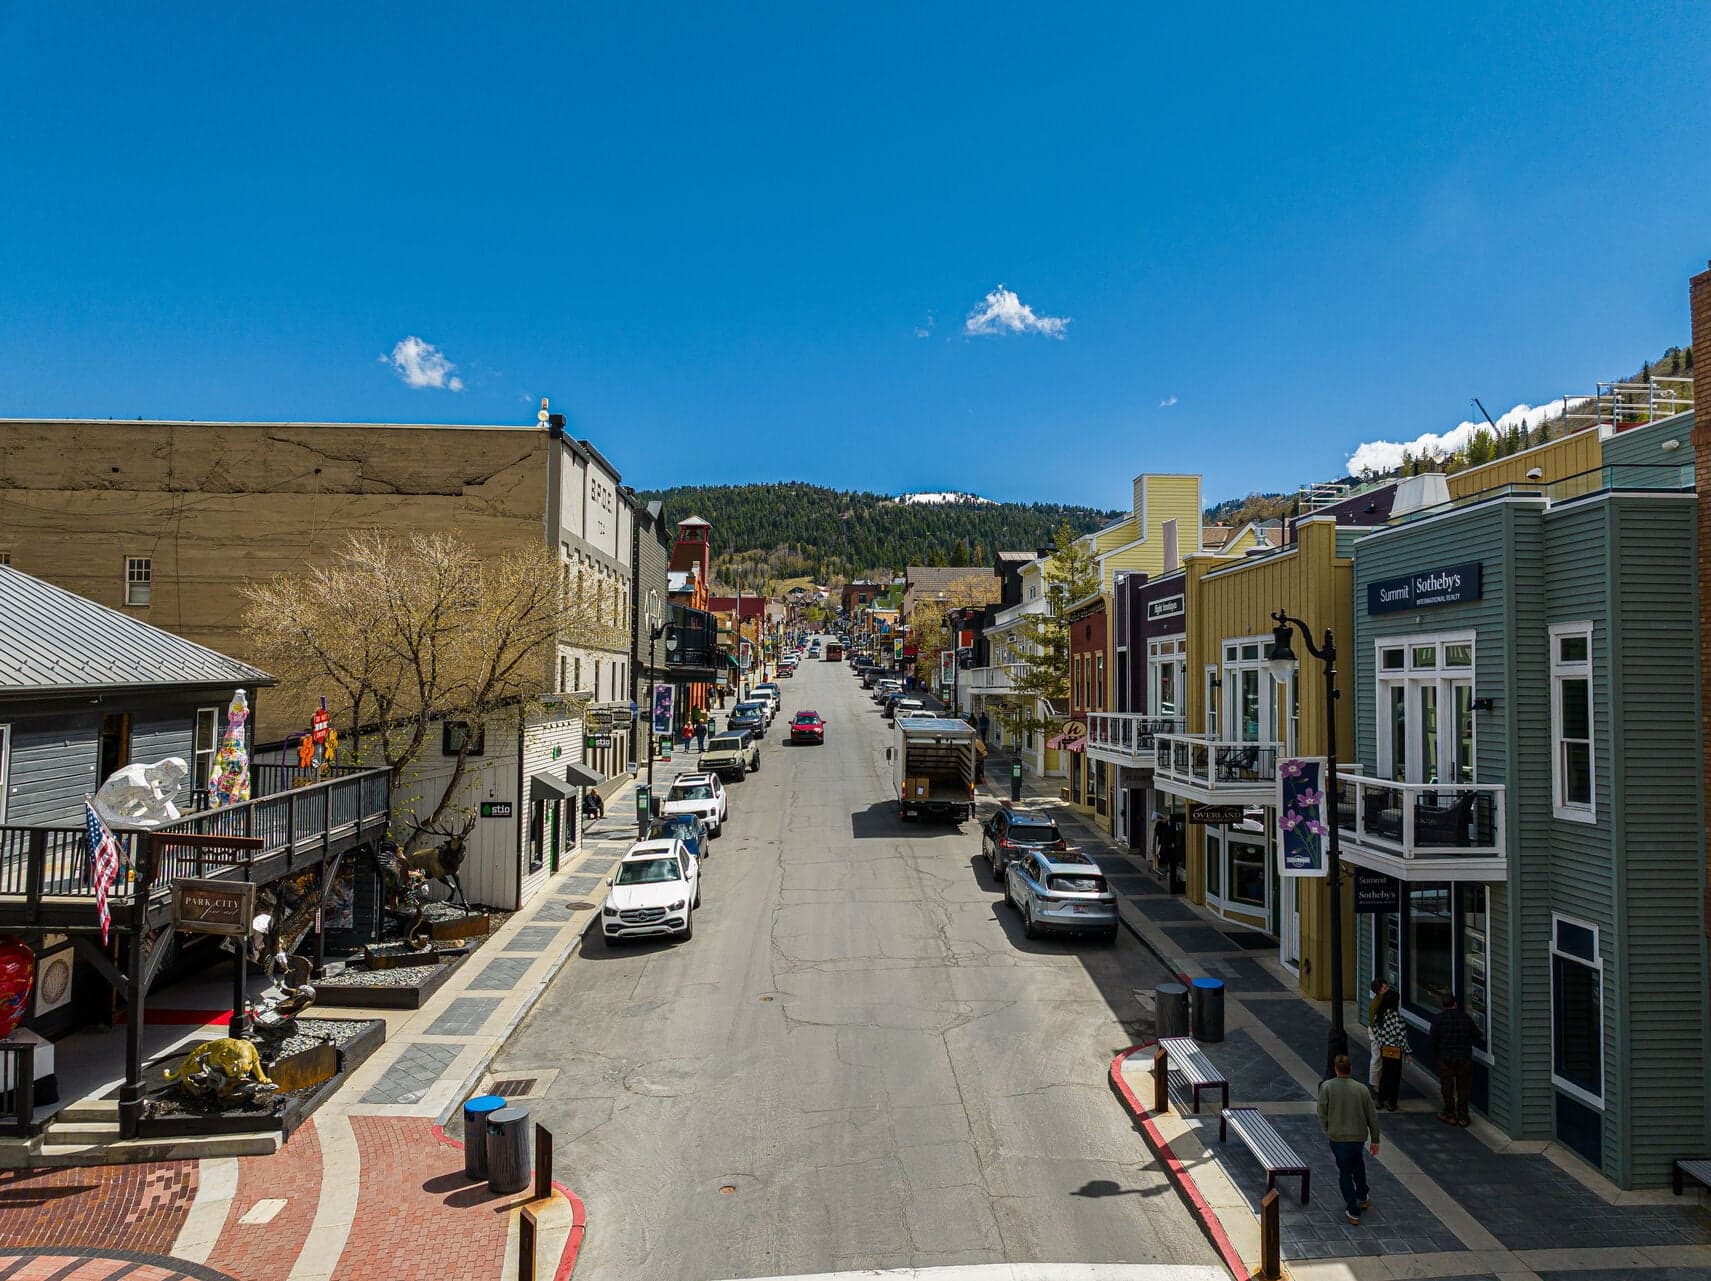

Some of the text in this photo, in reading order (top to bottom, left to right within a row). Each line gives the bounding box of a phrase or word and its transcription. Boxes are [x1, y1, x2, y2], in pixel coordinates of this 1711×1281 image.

[1380, 572, 1460, 602] Summit Sotheby's
[491, 805, 510, 813] stio
[1192, 811, 1241, 819] OVERLAND
[1359, 890, 1396, 900] Sotheby's
[185, 896, 238, 909] PARK CITY
